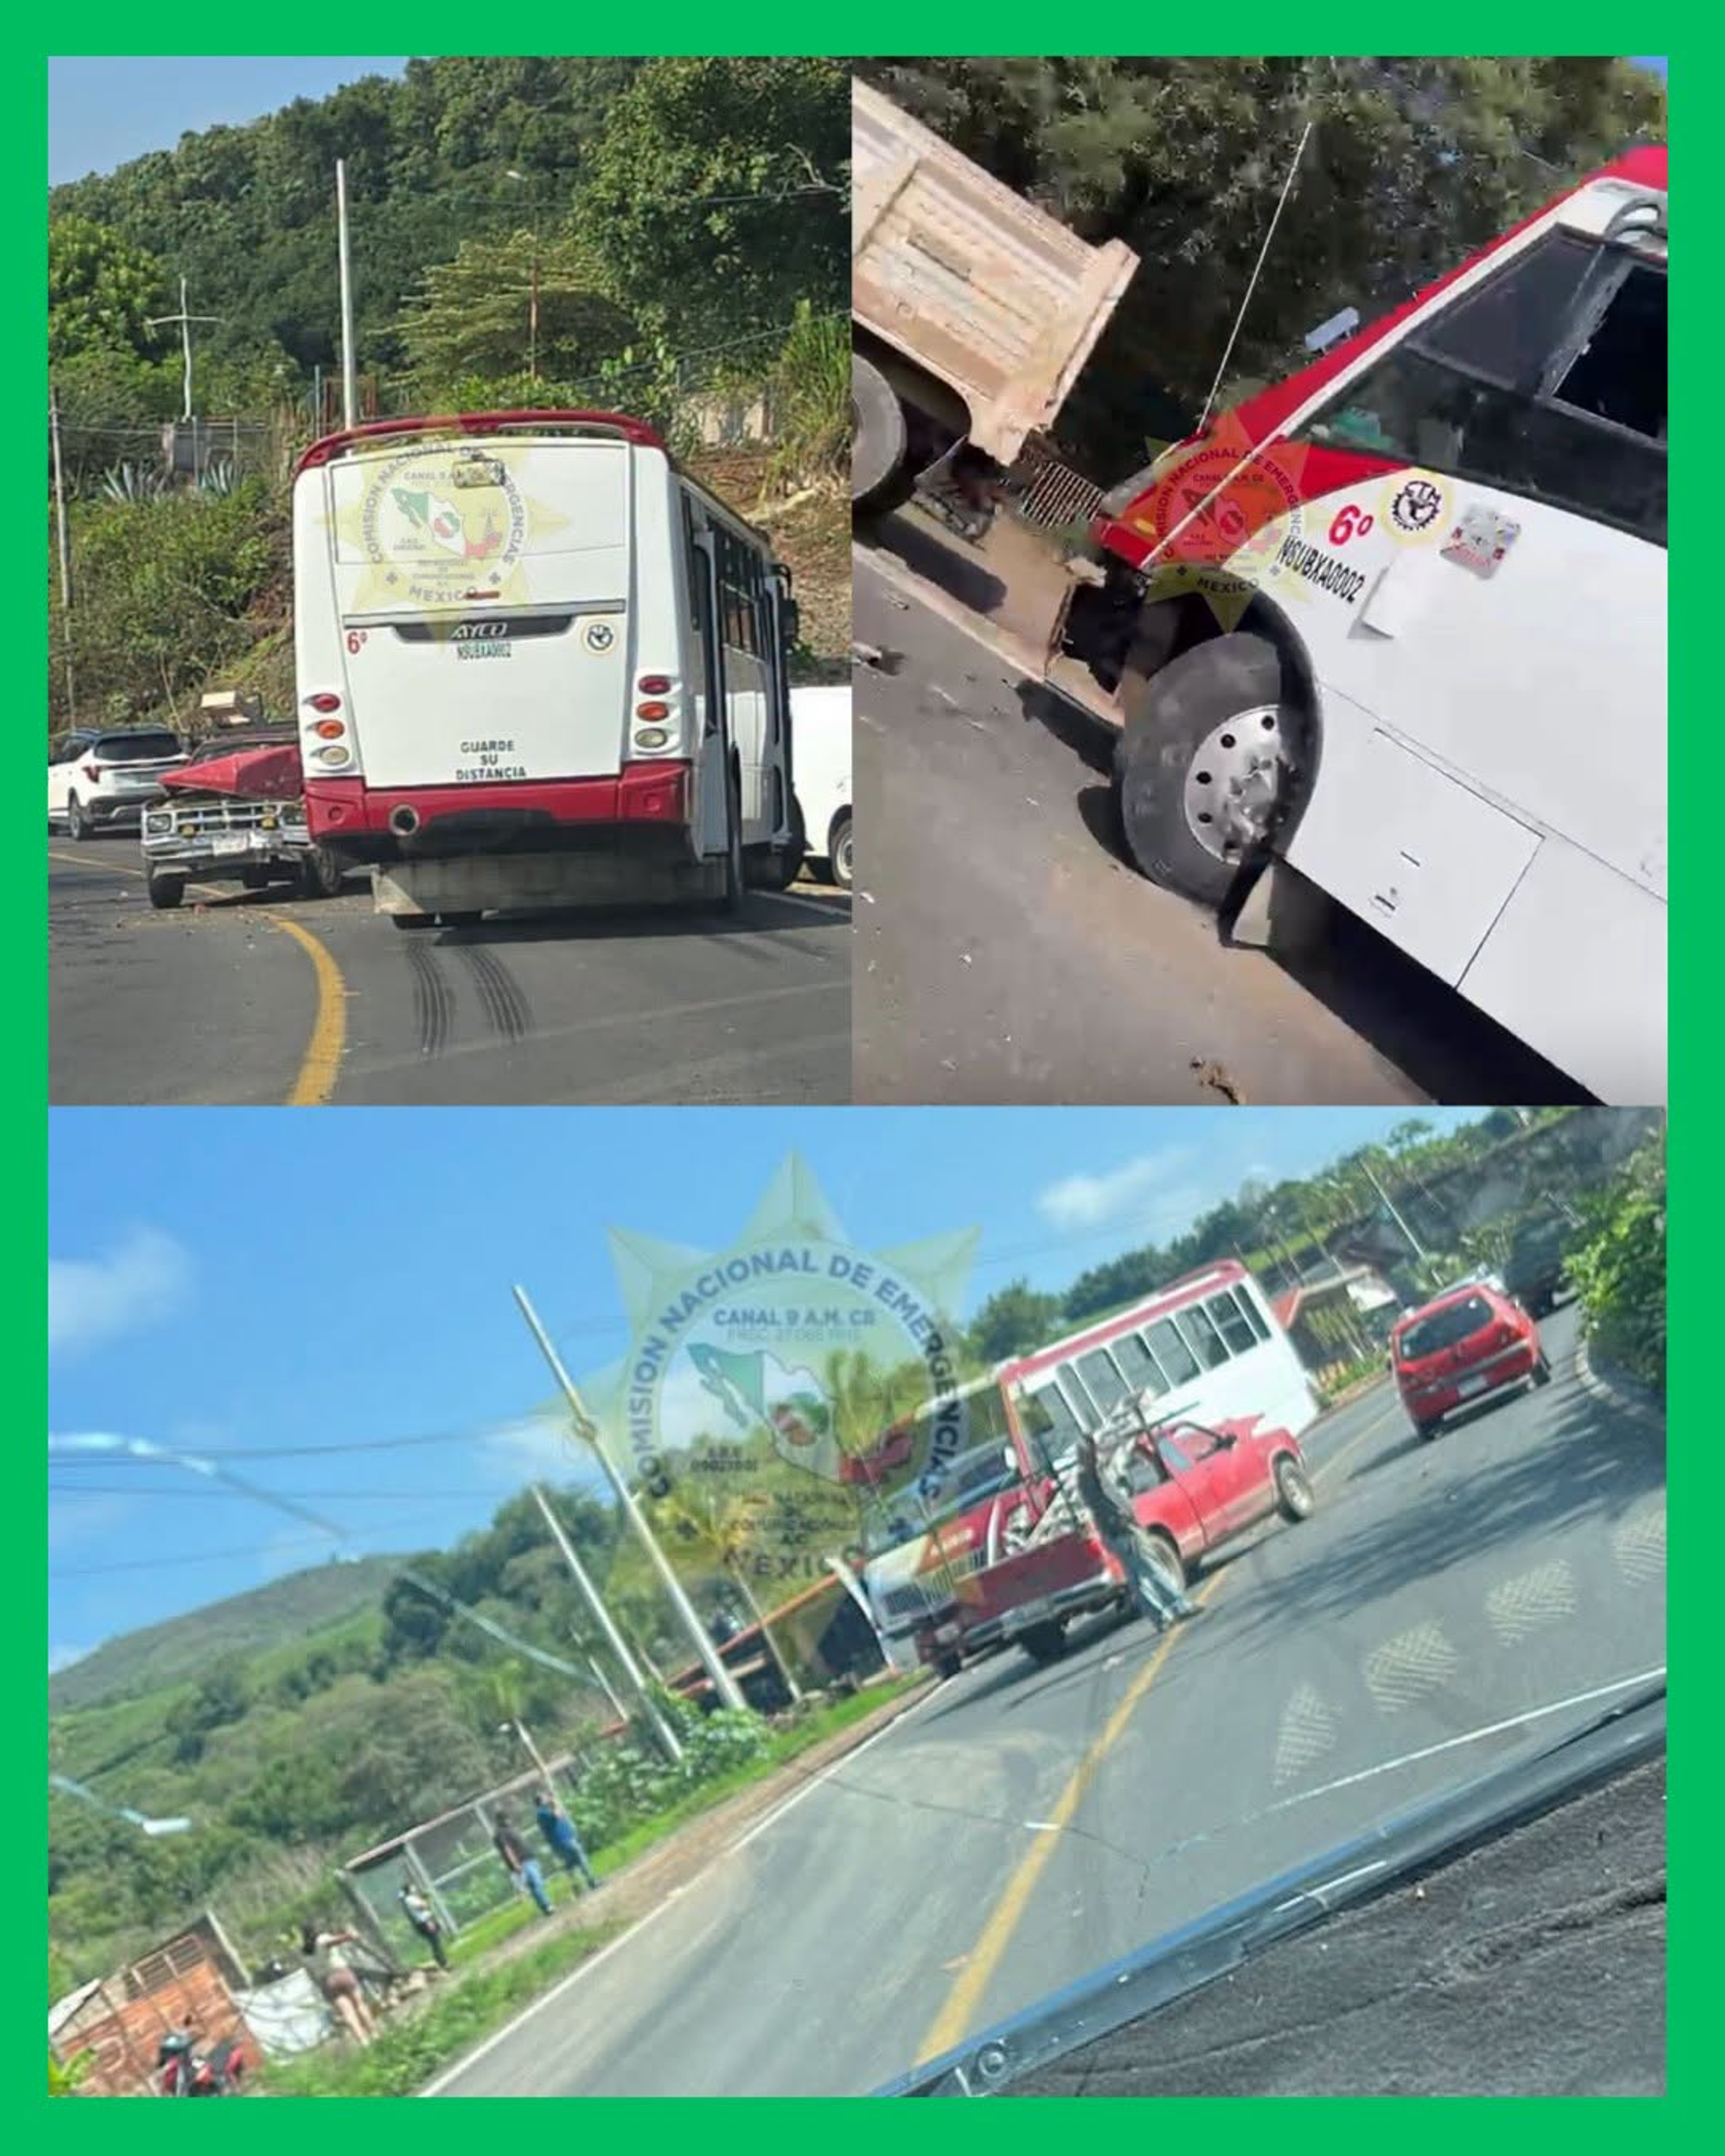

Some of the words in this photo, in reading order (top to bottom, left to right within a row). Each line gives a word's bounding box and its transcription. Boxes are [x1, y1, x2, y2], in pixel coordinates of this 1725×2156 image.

[461, 740, 515, 753] GUARDE
[480, 754, 498, 765] SU
[456, 766, 526, 781] DISTANCIA
